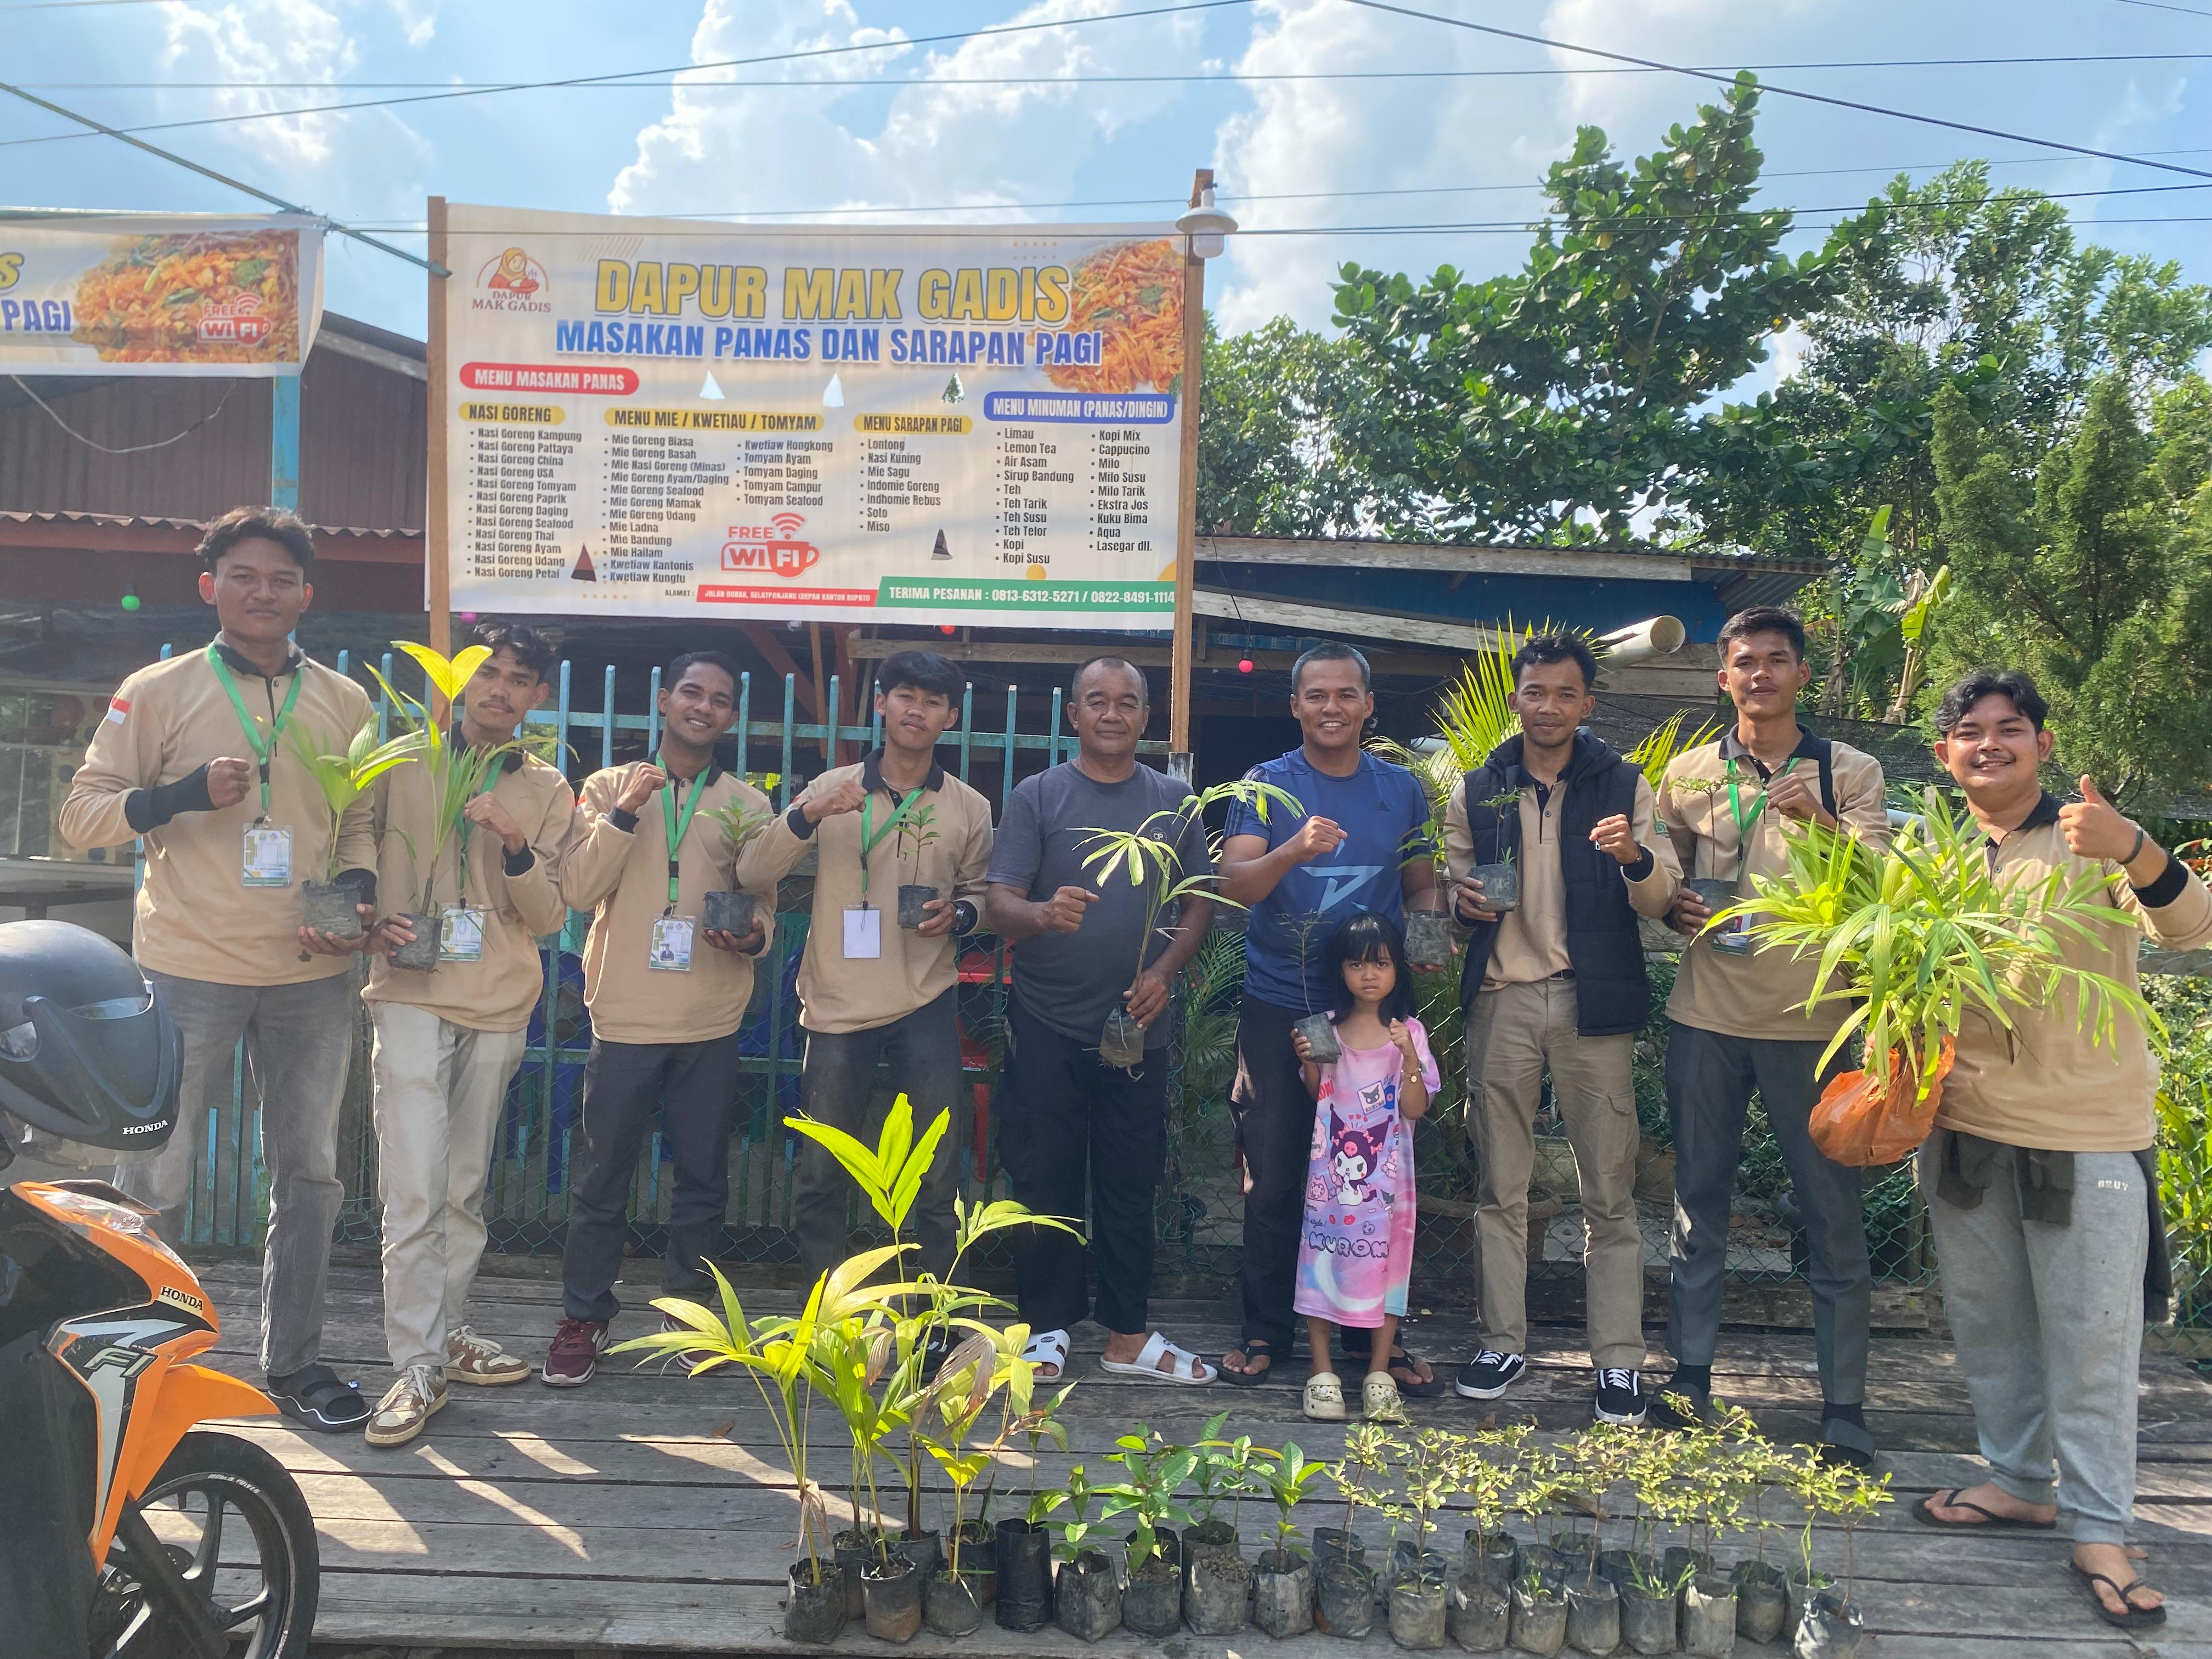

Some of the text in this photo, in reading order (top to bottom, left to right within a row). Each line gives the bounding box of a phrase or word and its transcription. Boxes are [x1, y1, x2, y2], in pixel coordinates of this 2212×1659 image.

[493, 290, 532, 301] DAPUR
[595, 259, 1072, 323] DAPUR MAK GADIS
[204, 304, 237, 315] FREE
[472, 298, 551, 313] MAK GADIS
[2, 300, 71, 331] PAGI
[556, 319, 1102, 365] MASAKAN PANAS DAN SARAPAN PAGI
[475, 369, 625, 391] MENU MASAKAN PANAS
[469, 405, 551, 422] NASI GORENG
[994, 398, 1168, 418] MENU MINUMAN (PANAS/DINGIN)
[614, 410, 816, 430] MENU MIE KWETIAU TOMYAM
[864, 416, 962, 432] MENU SARAPAN PAGI
[478, 428, 582, 442] Nasi Goreng Kampung
[1005, 428, 1034, 439] Limau
[1099, 430, 1141, 442] Kopi Mix
[612, 435, 693, 447] Mie Goreng Biasa
[745, 440, 833, 452] Kwetiaw Hongkong
[868, 439, 905, 451] Lontong
[478, 441, 573, 454] Nasi Goreng Pattaya
[1005, 442, 1056, 454] Lemon Tea
[1099, 444, 1150, 456] Cappucino
[478, 454, 563, 466] Nasi Goreng China
[744, 453, 811, 465] Tomyam Ayam
[868, 453, 921, 465] Nasi Kuning
[1005, 456, 1047, 467] Air Asam
[1099, 458, 1120, 469] Milo
[477, 466, 554, 478] Nasi Goreng USA
[612, 460, 725, 472] Mie Nasi Goreng (Minas)
[868, 466, 910, 478] Mie Sagu
[611, 472, 729, 485] Mie Goreng Ayam/Daging
[744, 466, 817, 479] Tomyam Daging
[1004, 470, 1074, 483] Sirup Bandung
[1099, 472, 1146, 482] Milo Susu
[744, 480, 822, 493] Tomyam Campur
[868, 480, 939, 493] Indomie Goreng
[1004, 484, 1021, 494] Teh
[1098, 486, 1146, 496] Milo Tarik
[477, 492, 566, 504] Nasi Goreng Paprik
[610, 497, 701, 509] Mie Goreng Mamak
[744, 494, 823, 506] Tomyam Seafood
[868, 494, 941, 506] Indhomie Rebus
[1004, 498, 1047, 509] Teh Tarik
[477, 504, 568, 517] Nasi Goreng Daging
[1098, 500, 1148, 510] Ekstra Jos
[867, 507, 888, 518] Soto
[1004, 512, 1047, 523] Teh Susu
[1098, 514, 1147, 524] Kuku Bima
[610, 522, 658, 532] Mie Ladna
[867, 521, 889, 532] Miso
[1003, 526, 1047, 537] Teh Telor
[476, 529, 554, 541] Nasi Goreng Thai
[729, 527, 774, 539] FREE
[1097, 527, 1120, 539] Aqua
[610, 534, 672, 546] Mie Bandung
[1003, 539, 1024, 551] Kopi
[611, 548, 663, 557] Mie Hailam
[1097, 541, 1153, 552] Lasegar dll.
[1003, 553, 1050, 565] Kopi Susu
[611, 560, 693, 571] Kwetiaw Kantonis
[475, 567, 559, 579] Nasi Goreng Petai
[610, 572, 685, 584] Kwetiaw Kungfu
[822, 593, 845, 601] KANTOR
[889, 587, 1175, 603] TERIMA PESANAN 0813-6312-5271 0822-8491-1114
[122, 1120, 168, 1135] HONDA
[161, 1286, 203, 1311] HONDA
[83, 1347, 158, 1378] FI
